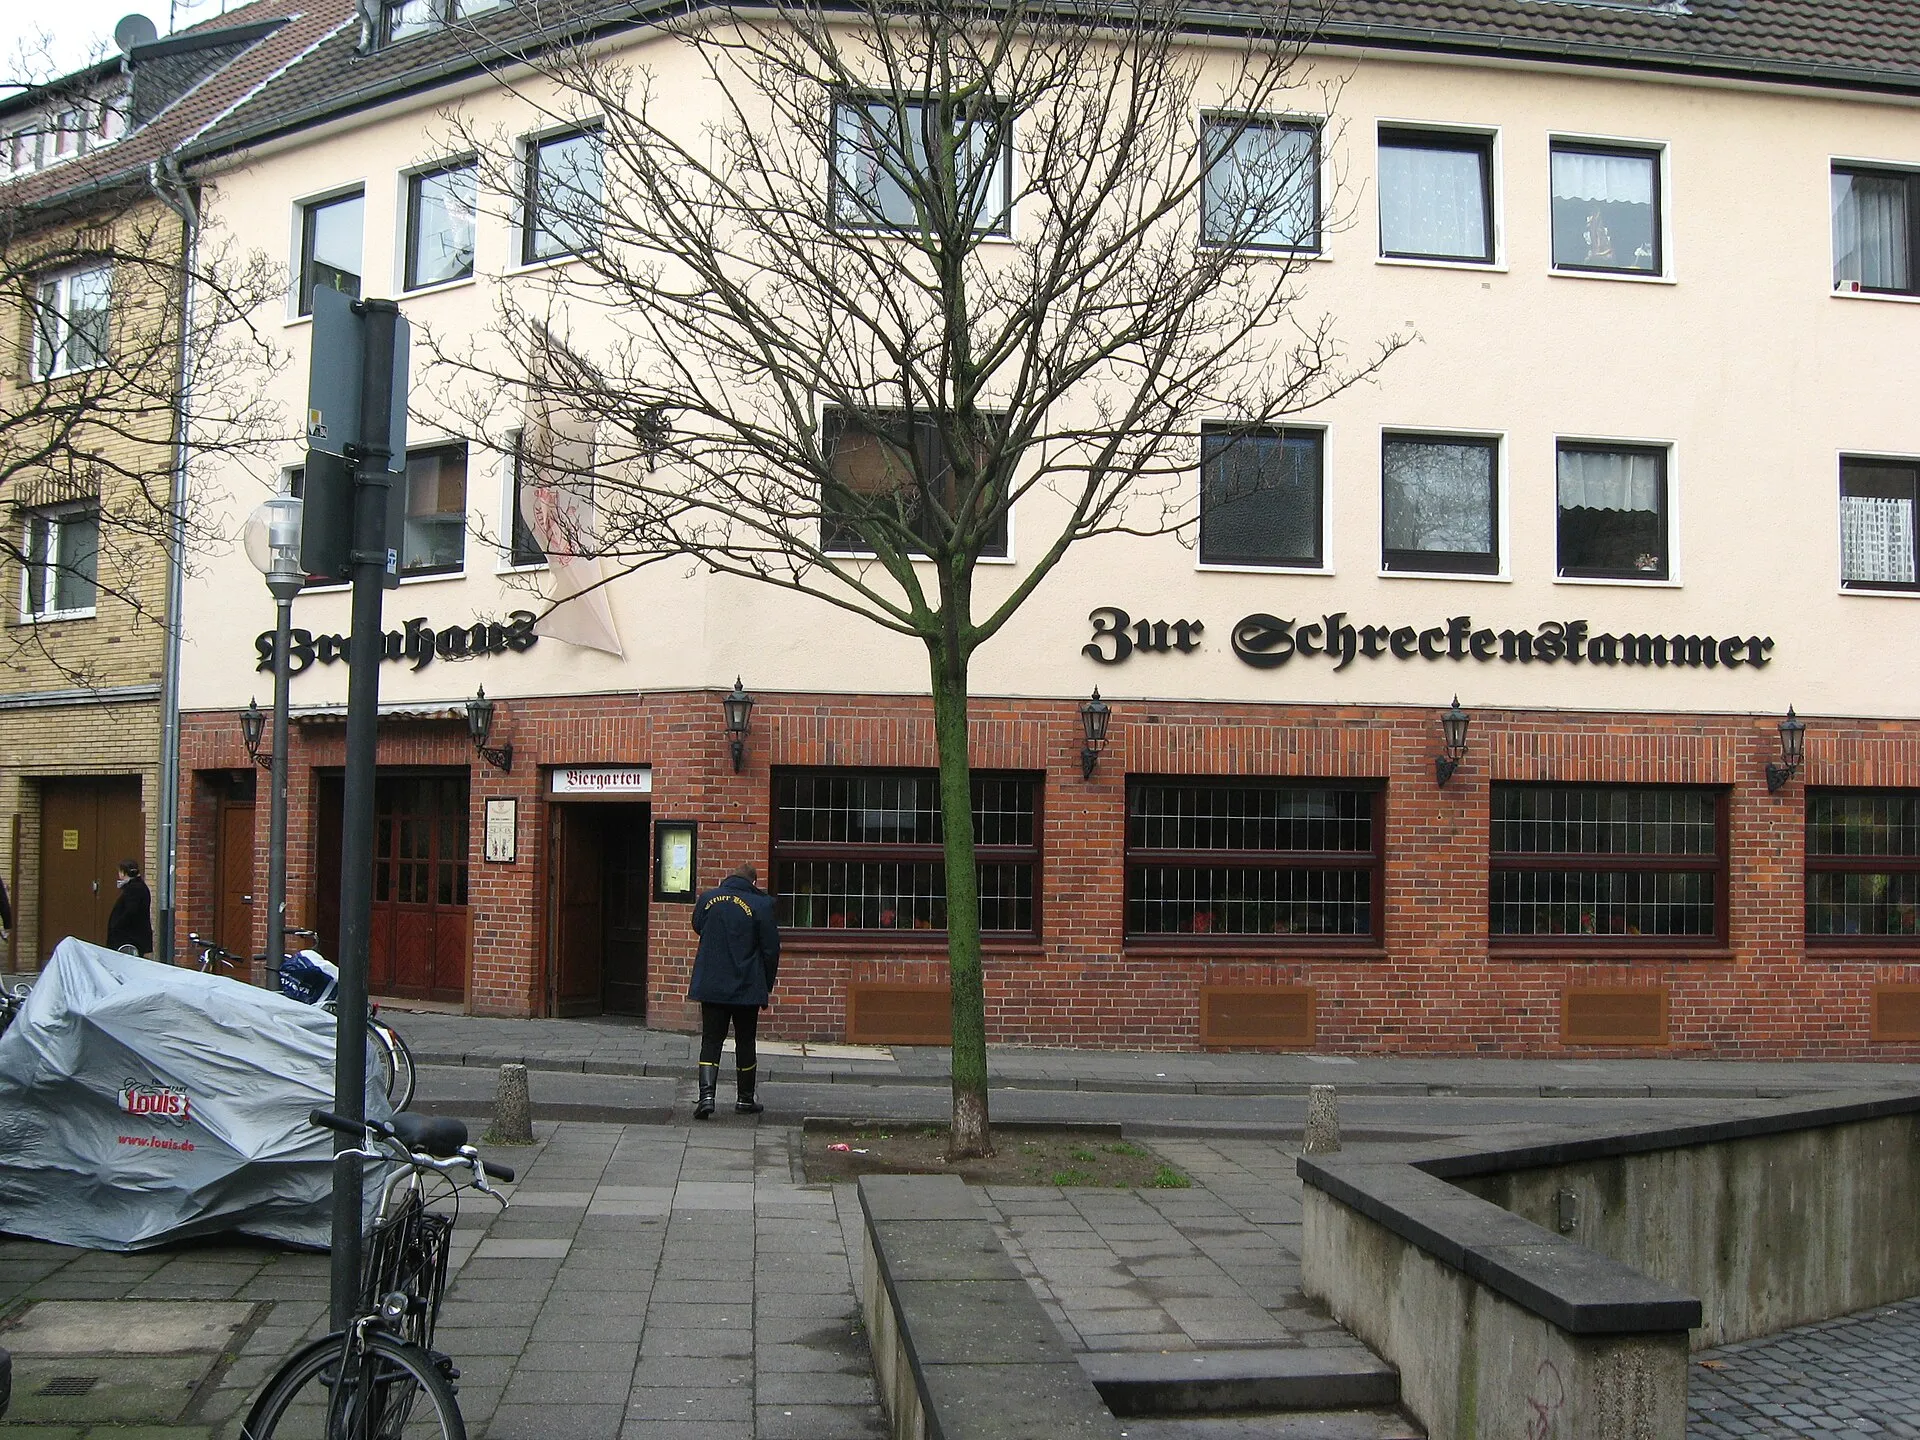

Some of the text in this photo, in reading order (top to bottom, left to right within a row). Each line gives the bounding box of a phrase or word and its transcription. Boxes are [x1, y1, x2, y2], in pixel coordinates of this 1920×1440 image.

[1082, 607, 1774, 672] Zur Schreckenskammer
[566, 770, 641, 790] Biergarten
[128, 1090, 179, 1113] Louis
[118, 1136, 195, 1152] www.louis.de
